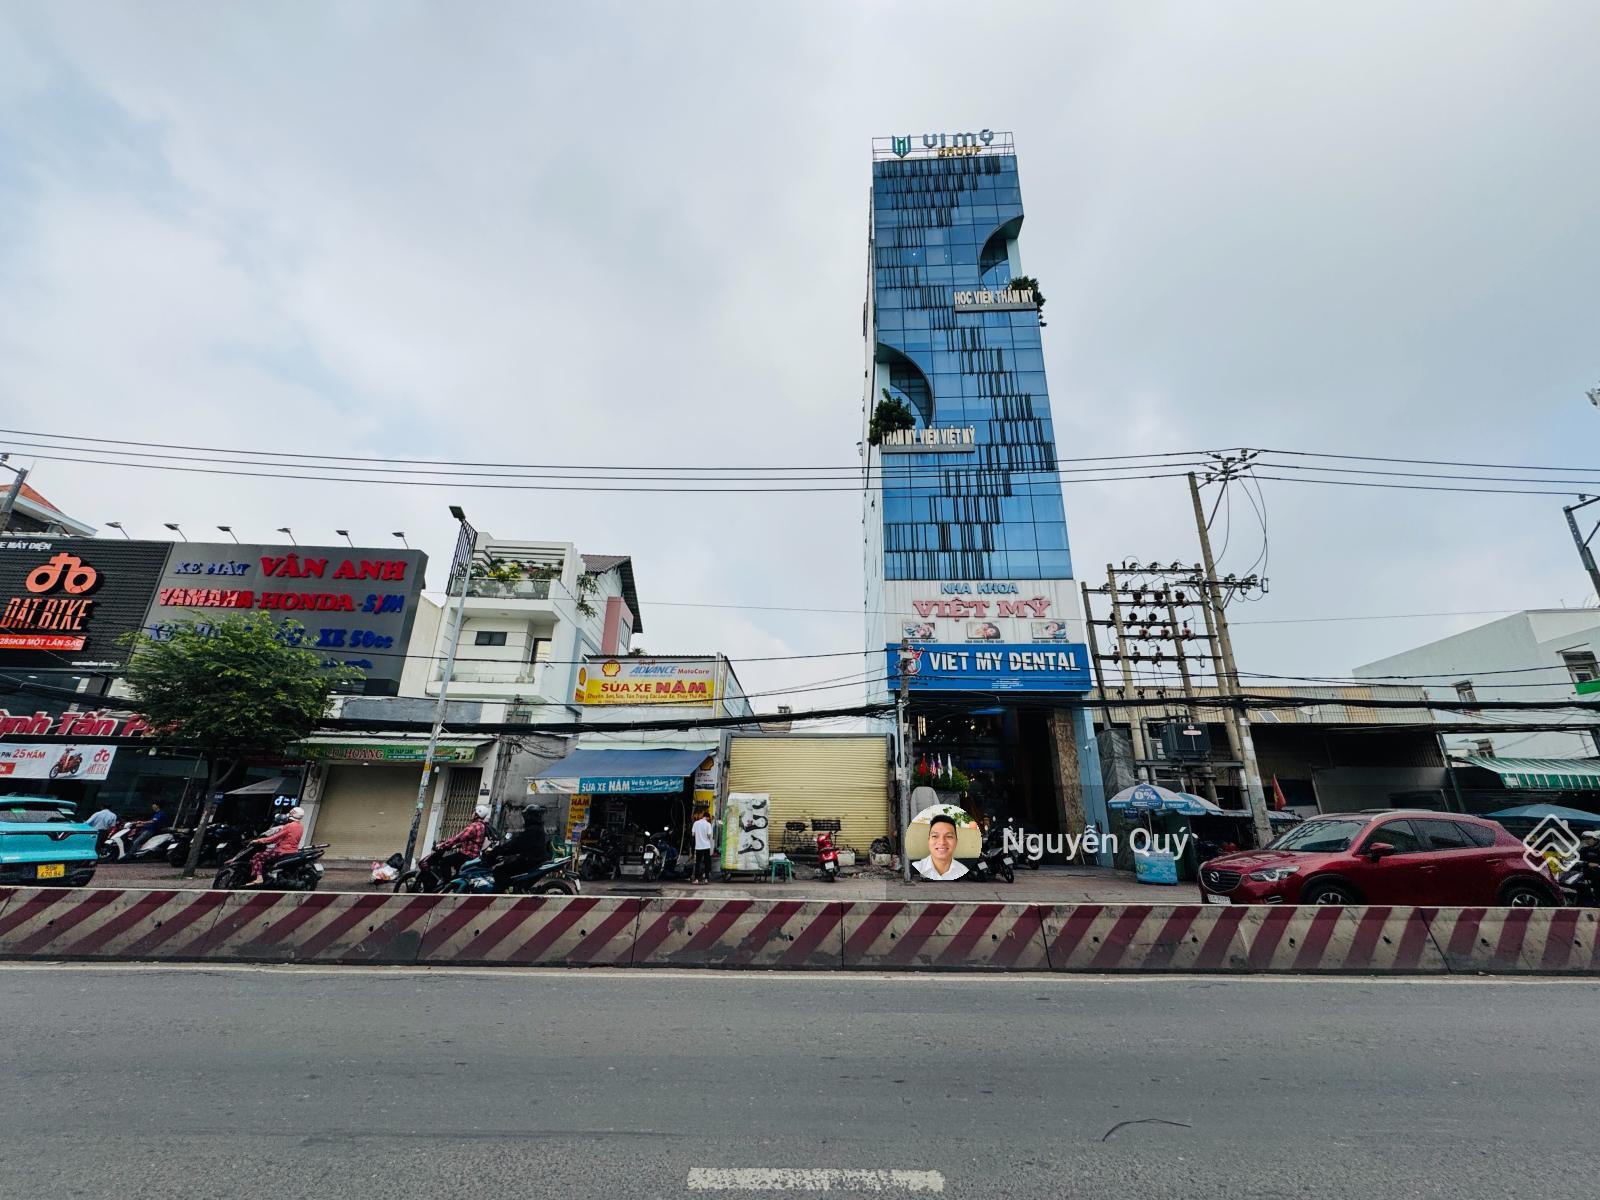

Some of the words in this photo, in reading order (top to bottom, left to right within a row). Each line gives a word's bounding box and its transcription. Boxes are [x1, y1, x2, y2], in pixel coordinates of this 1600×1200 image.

[937, 146, 982, 157] GROUP
[954, 291, 973, 306] HỌC
[974, 287, 995, 306] VIỆN
[260, 553, 329, 579] VÂN
[333, 559, 408, 581] ANH
[941, 582, 973, 595] NHA
[977, 582, 1019, 595] KHOA
[912, 596, 990, 622] VIỆT
[997, 595, 1052, 618] MỸ
[317, 628, 347, 648] XE
[349, 629, 394, 649] 50cc
[929, 651, 970, 671] VIET
[976, 651, 1003, 671] MY
[1008, 651, 1081, 672] DENTAL
[629, 665, 679, 674] ADVANCE
[601, 680, 631, 693] SỬA
[632, 683, 652, 693] XE
[655, 680, 708, 694] NĂM
[12, 748, 26, 759] 25
[581, 780, 596, 792] SỬA
[597, 783, 606, 792] XE
